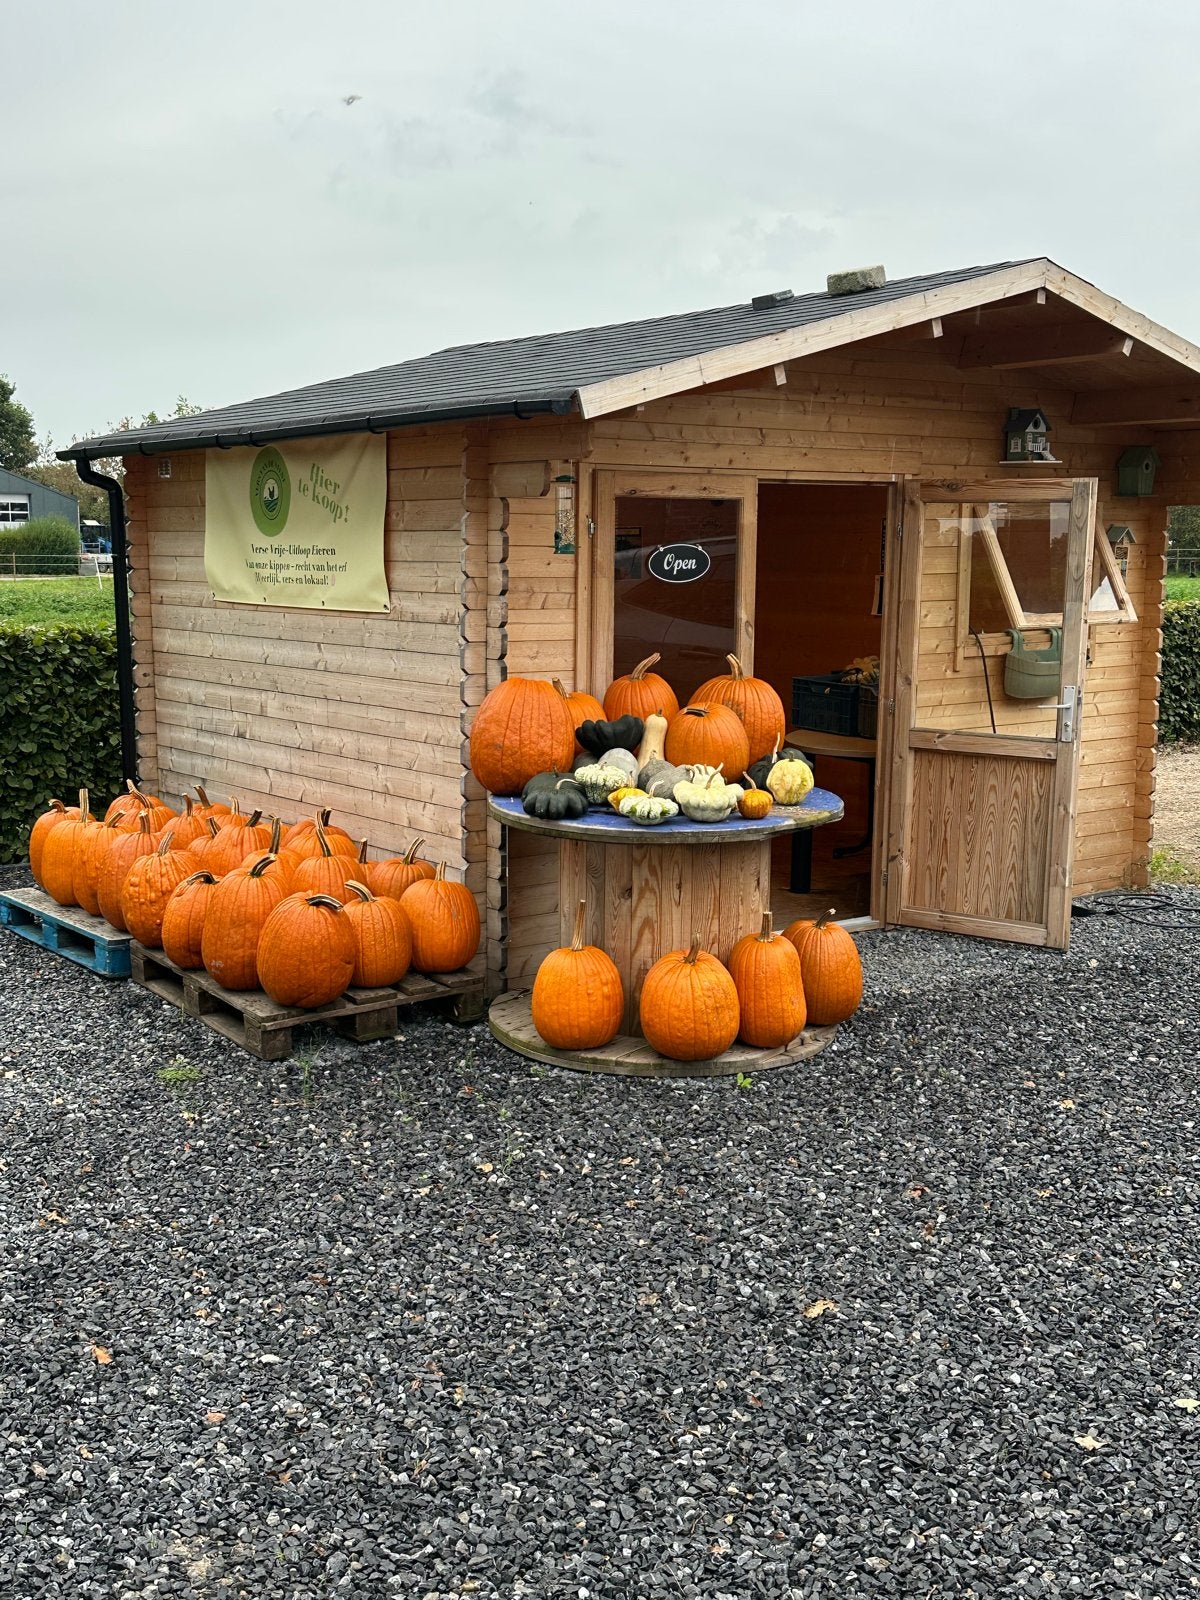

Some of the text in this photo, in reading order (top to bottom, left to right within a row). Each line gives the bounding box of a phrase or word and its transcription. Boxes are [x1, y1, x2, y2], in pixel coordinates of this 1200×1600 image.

[310, 463, 340, 495] Hier
[298, 479, 350, 524] te koop!
[251, 543, 269, 555] Verse
[311, 544, 336, 556] Eieren
[269, 560, 290, 573] kippen
[295, 561, 311, 572] recht
[312, 564, 325, 572] van
[326, 562, 338, 572] het
[663, 553, 697, 575] Open
[304, 574, 329, 586] lokaal!
